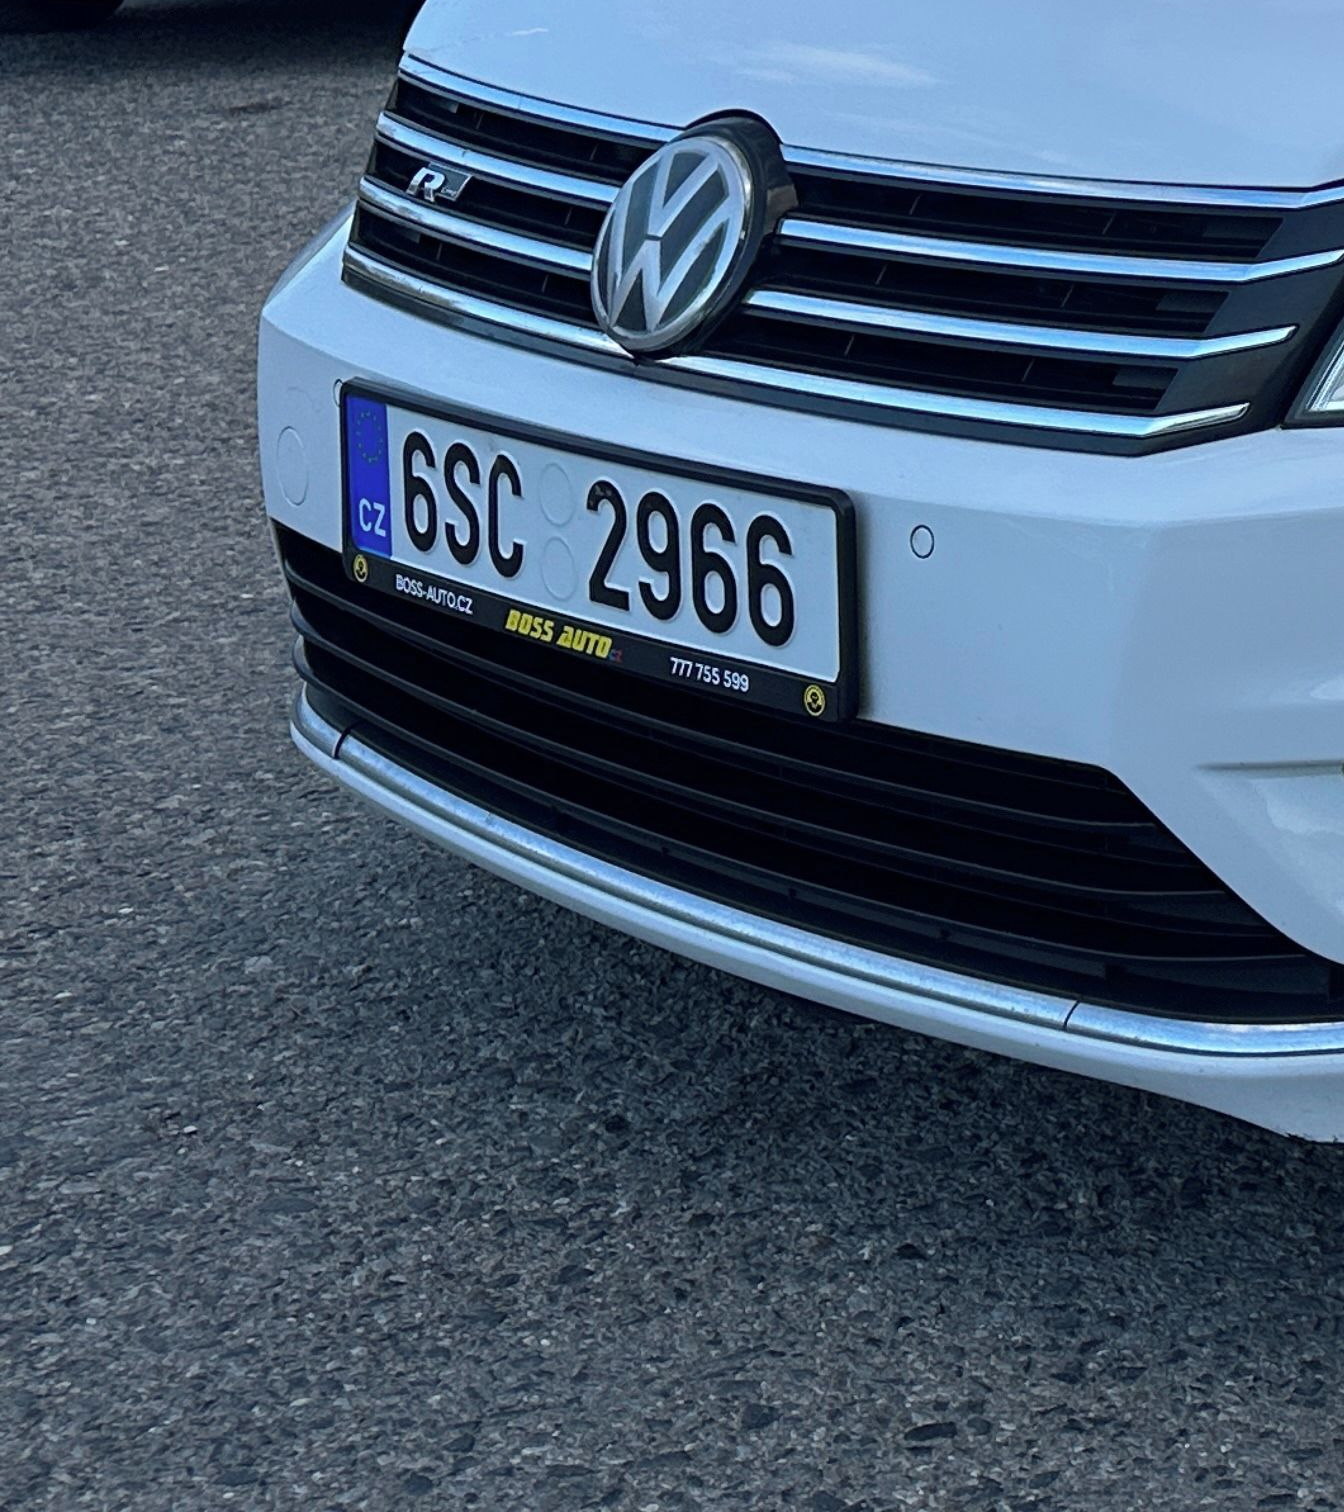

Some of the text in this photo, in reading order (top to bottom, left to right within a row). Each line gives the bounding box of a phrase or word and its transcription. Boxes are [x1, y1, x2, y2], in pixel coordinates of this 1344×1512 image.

[358, 497, 387, 538] CZ
[402, 430, 795, 647] 6SC 2966
[395, 573, 474, 616] BOSS-AUTO.CZ
[505, 609, 555, 642] BOSS
[556, 625, 613, 659] AUTO
[670, 656, 749, 693] 777 755 599
